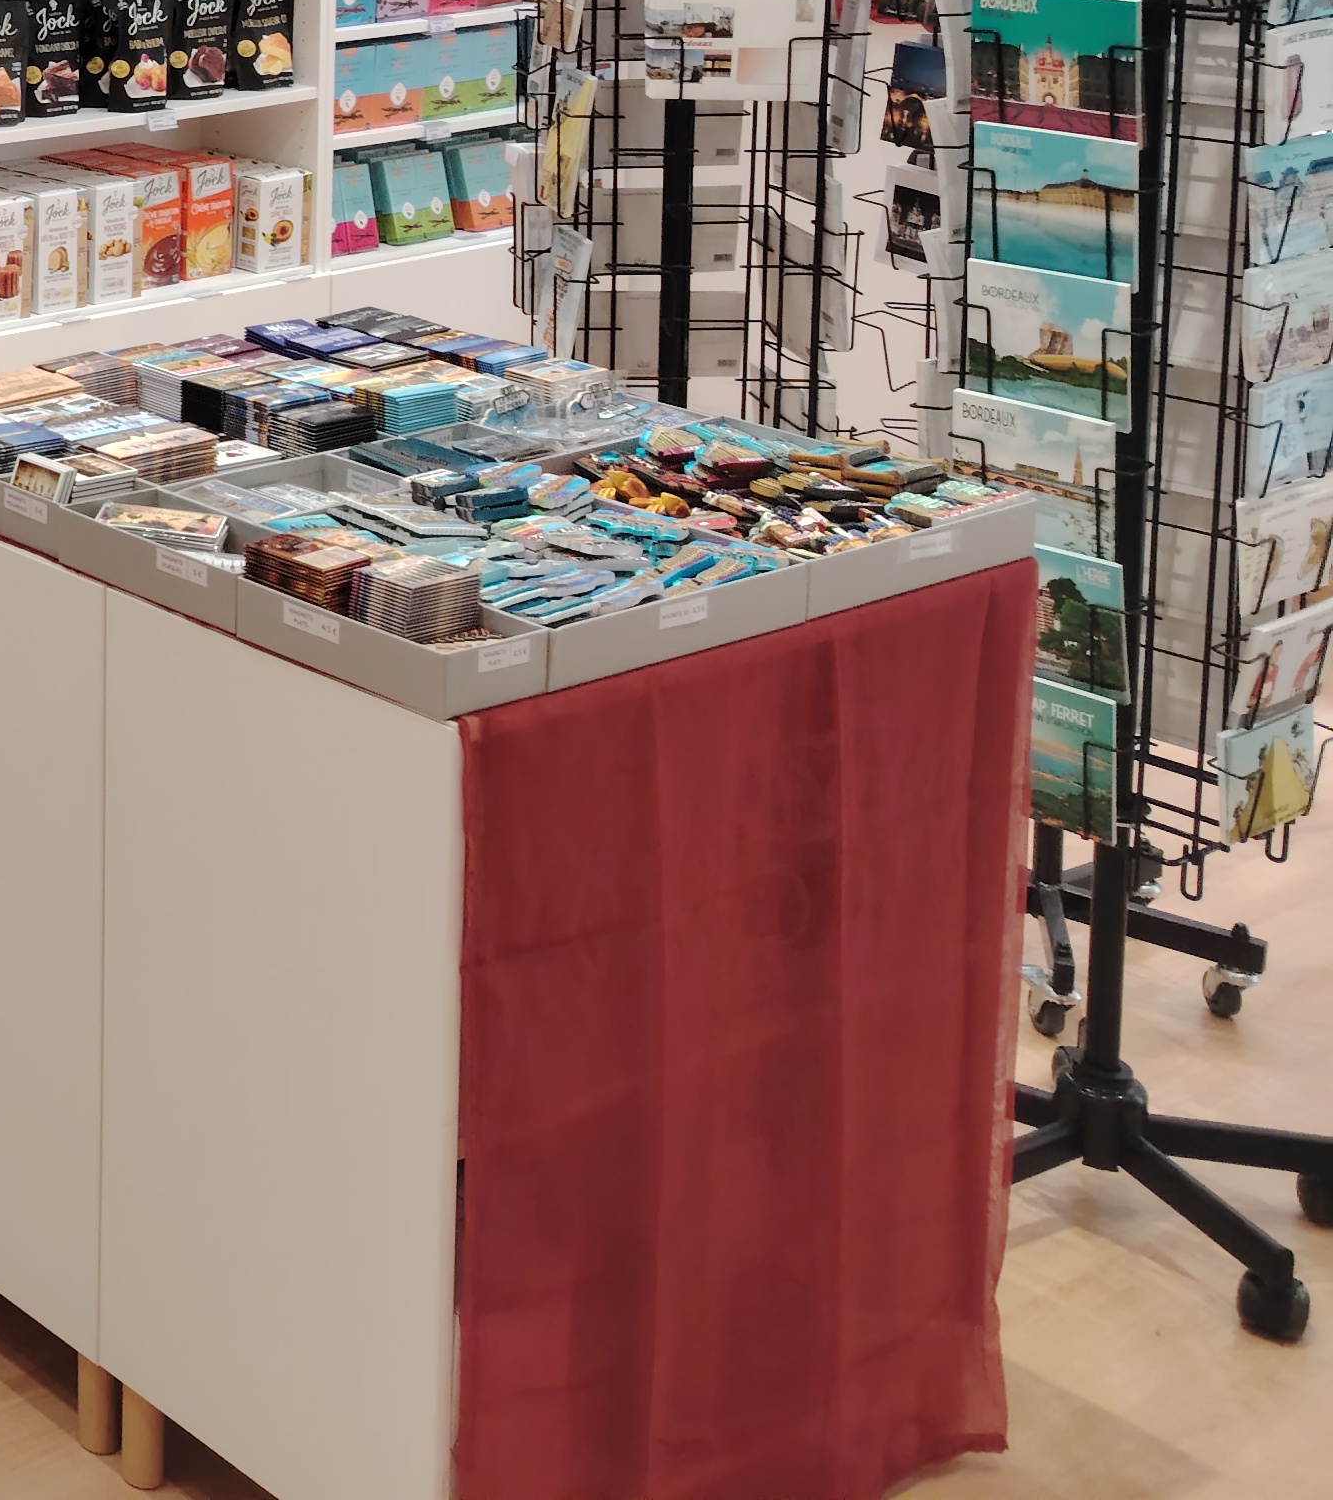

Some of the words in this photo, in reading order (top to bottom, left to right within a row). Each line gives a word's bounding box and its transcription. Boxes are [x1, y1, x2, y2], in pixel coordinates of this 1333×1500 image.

[36, 4, 79, 41] Jock
[128, 0, 168, 36] Jock
[143, 178, 176, 210] Jock
[195, 170, 228, 196] Jock
[103, 195, 128, 216] Jock
[270, 187, 294, 207] Jock
[46, 202, 71, 225] Jock
[981, 284, 1041, 305] BORDEAUX
[962, 402, 1016, 428] BORDEAUX
[1050, 703, 1095, 729] FERRET
